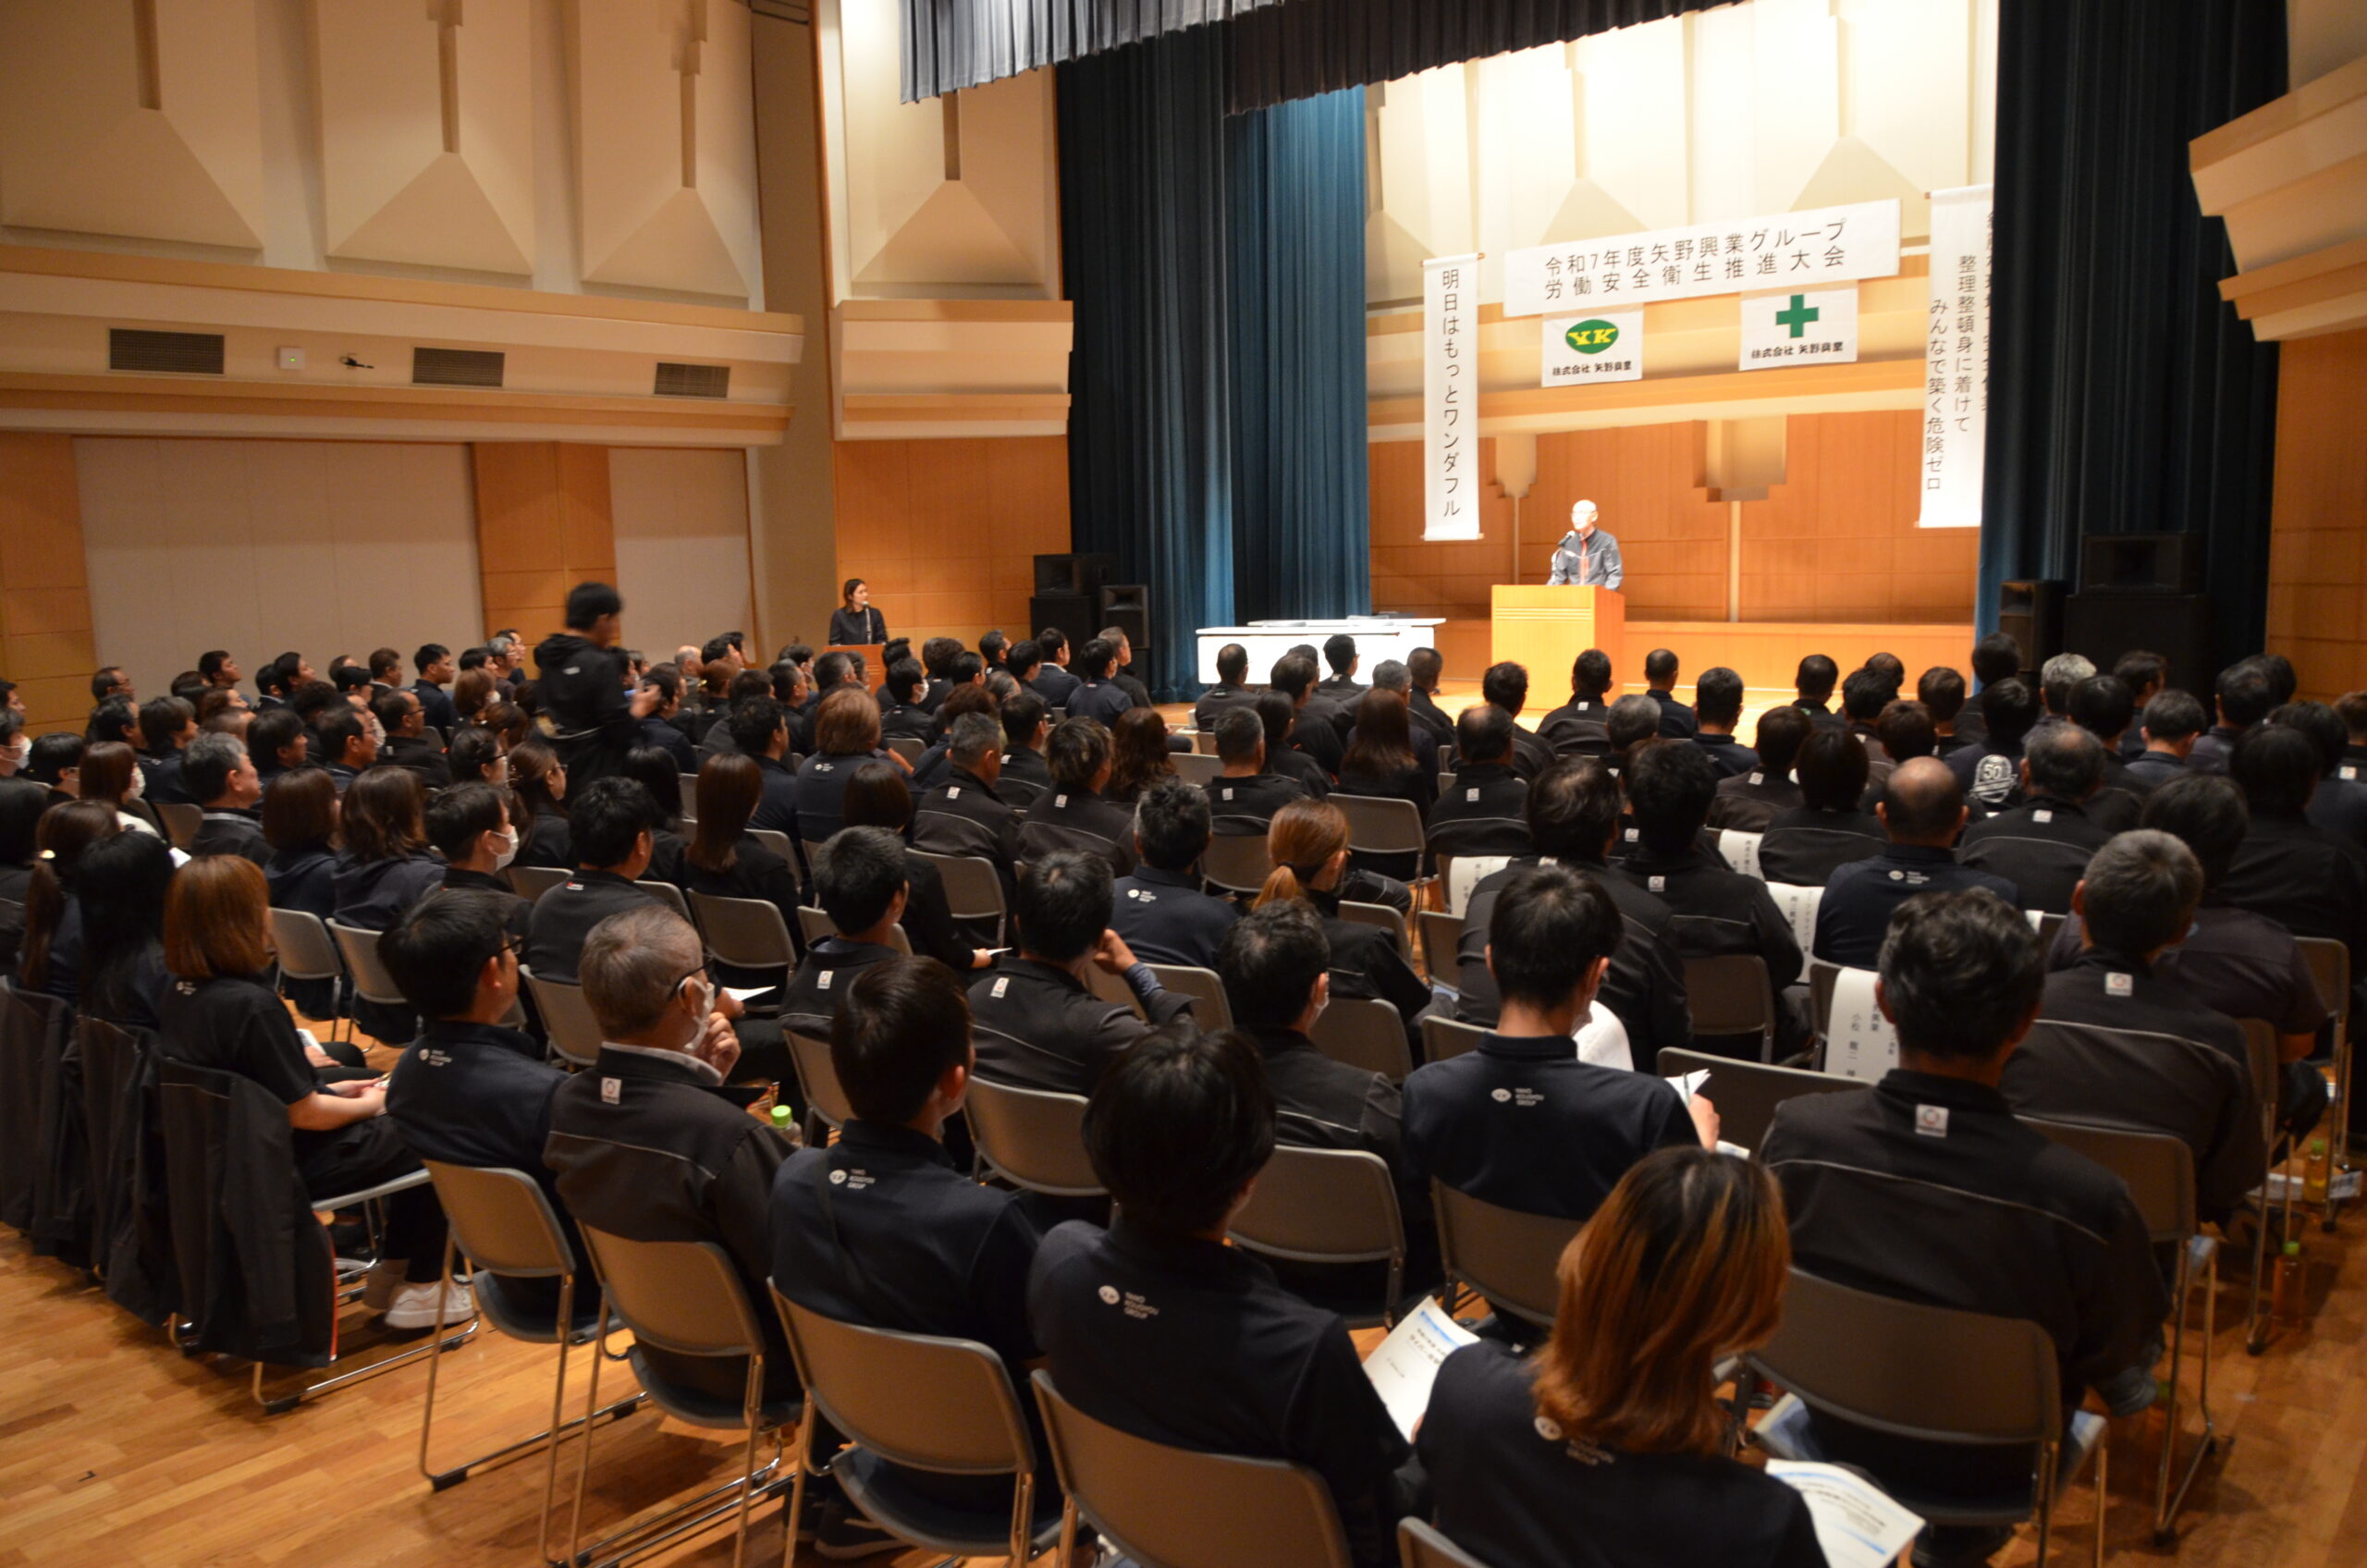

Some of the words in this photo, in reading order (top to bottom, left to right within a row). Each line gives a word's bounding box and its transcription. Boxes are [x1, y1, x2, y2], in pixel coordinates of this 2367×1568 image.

[1545, 217, 1847, 276] 令和7年度矢野興業グループ
[1545, 245, 1846, 300] 労働安全衛生推進大会
[1442, 269, 1460, 518] 明日はもっとワンダフル
[1567, 327, 1617, 346] YK
[1926, 298, 1948, 491] みんなで築く危険ゼロ
[1954, 254, 1977, 433] 整理整頓身に着けて
